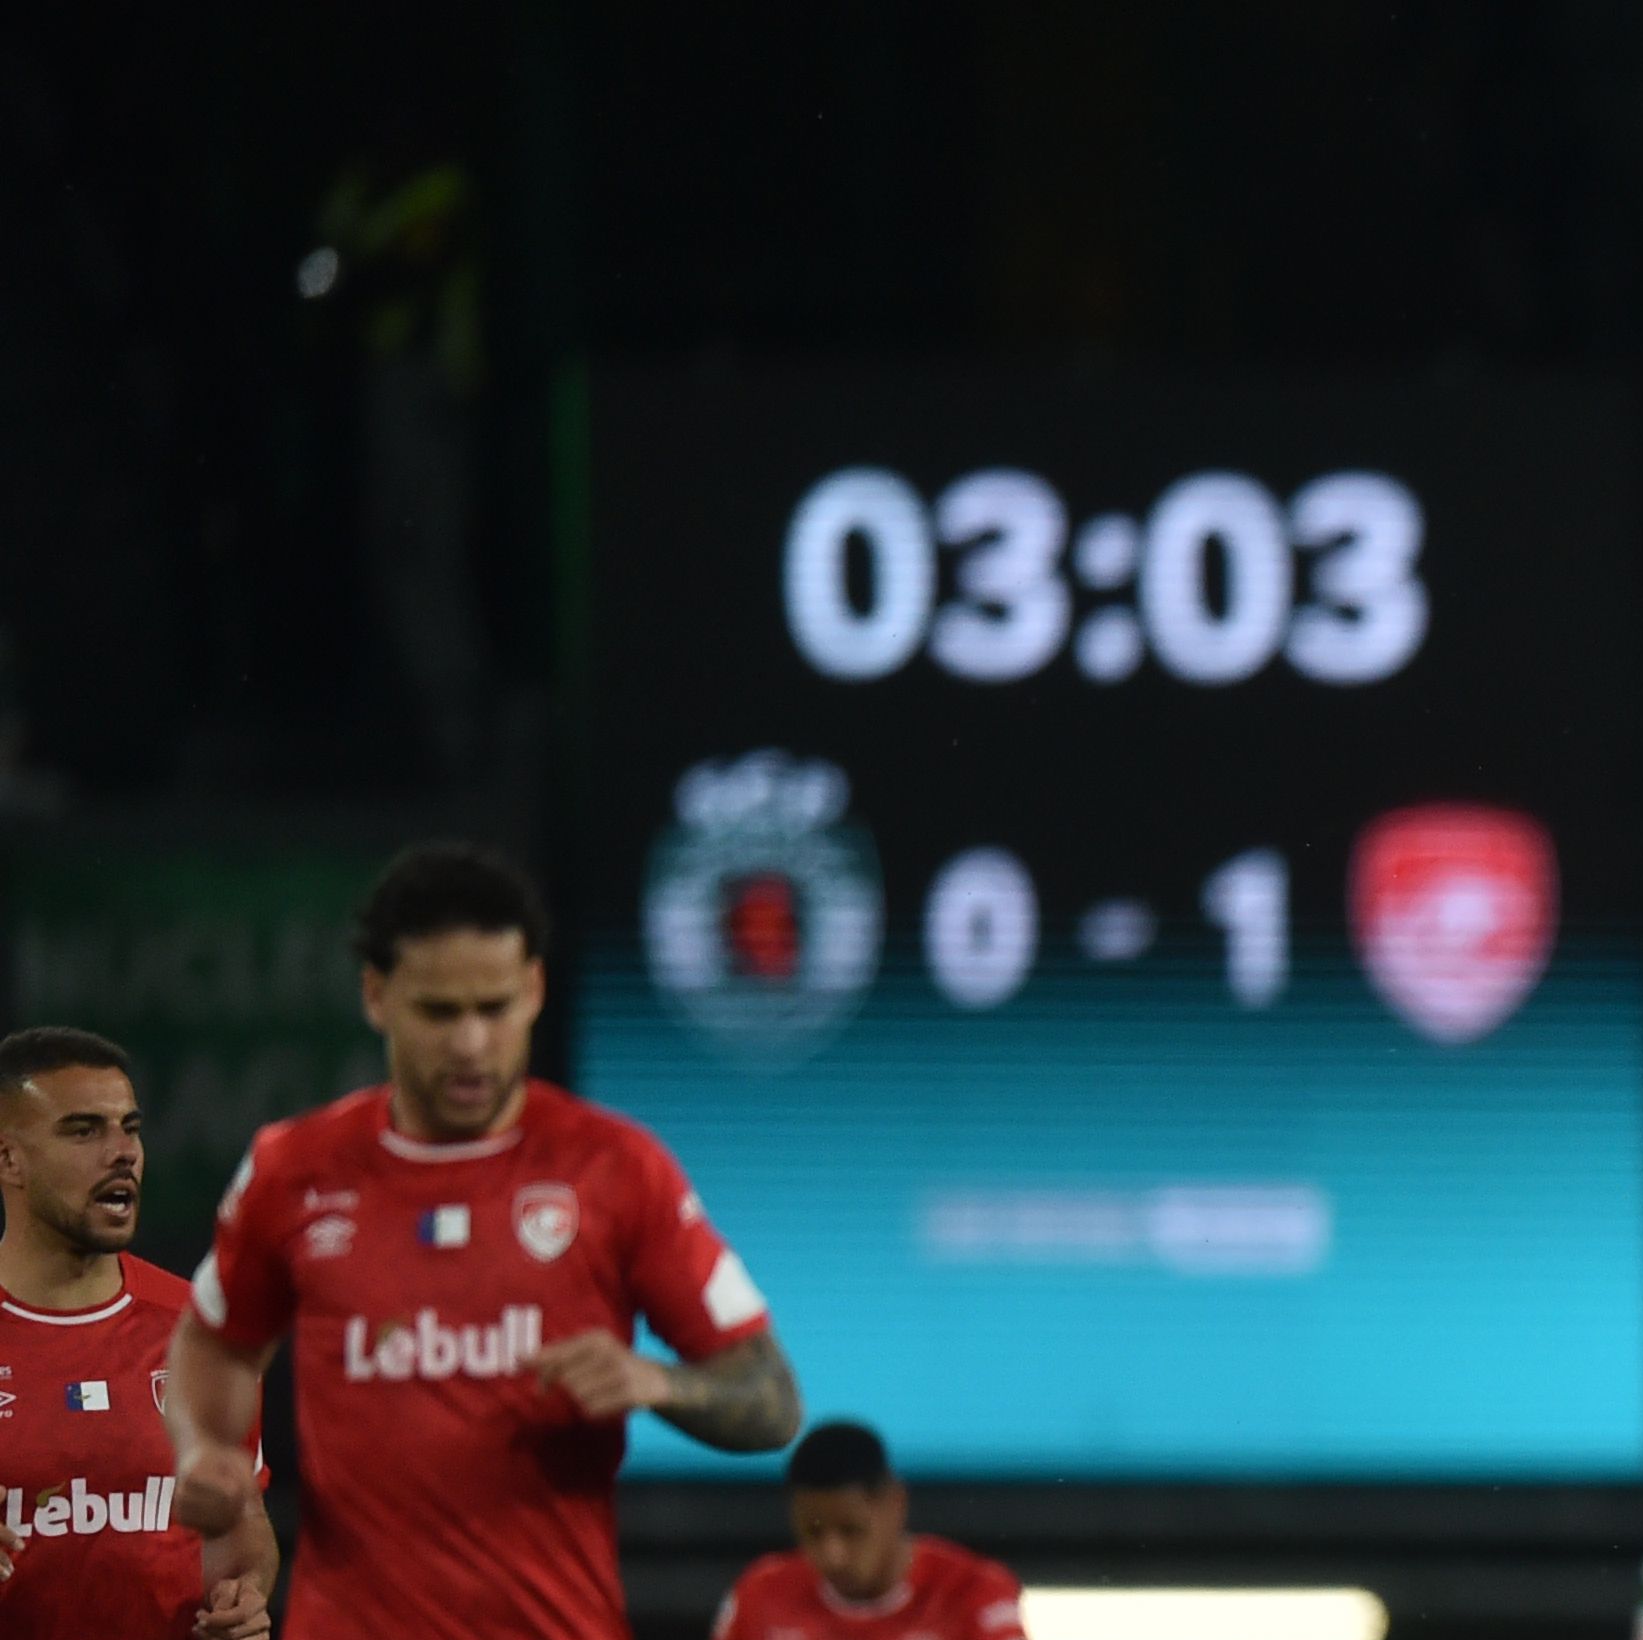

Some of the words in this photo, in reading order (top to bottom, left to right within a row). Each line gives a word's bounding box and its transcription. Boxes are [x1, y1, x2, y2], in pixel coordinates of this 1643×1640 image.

[784, 468, 1427, 684] 03:03
[925, 848, 1036, 1008] 0
[1207, 848, 1290, 1008] 1
[345, 1305, 543, 1382] Lebull
[6, 1476, 176, 1537] Lebull
